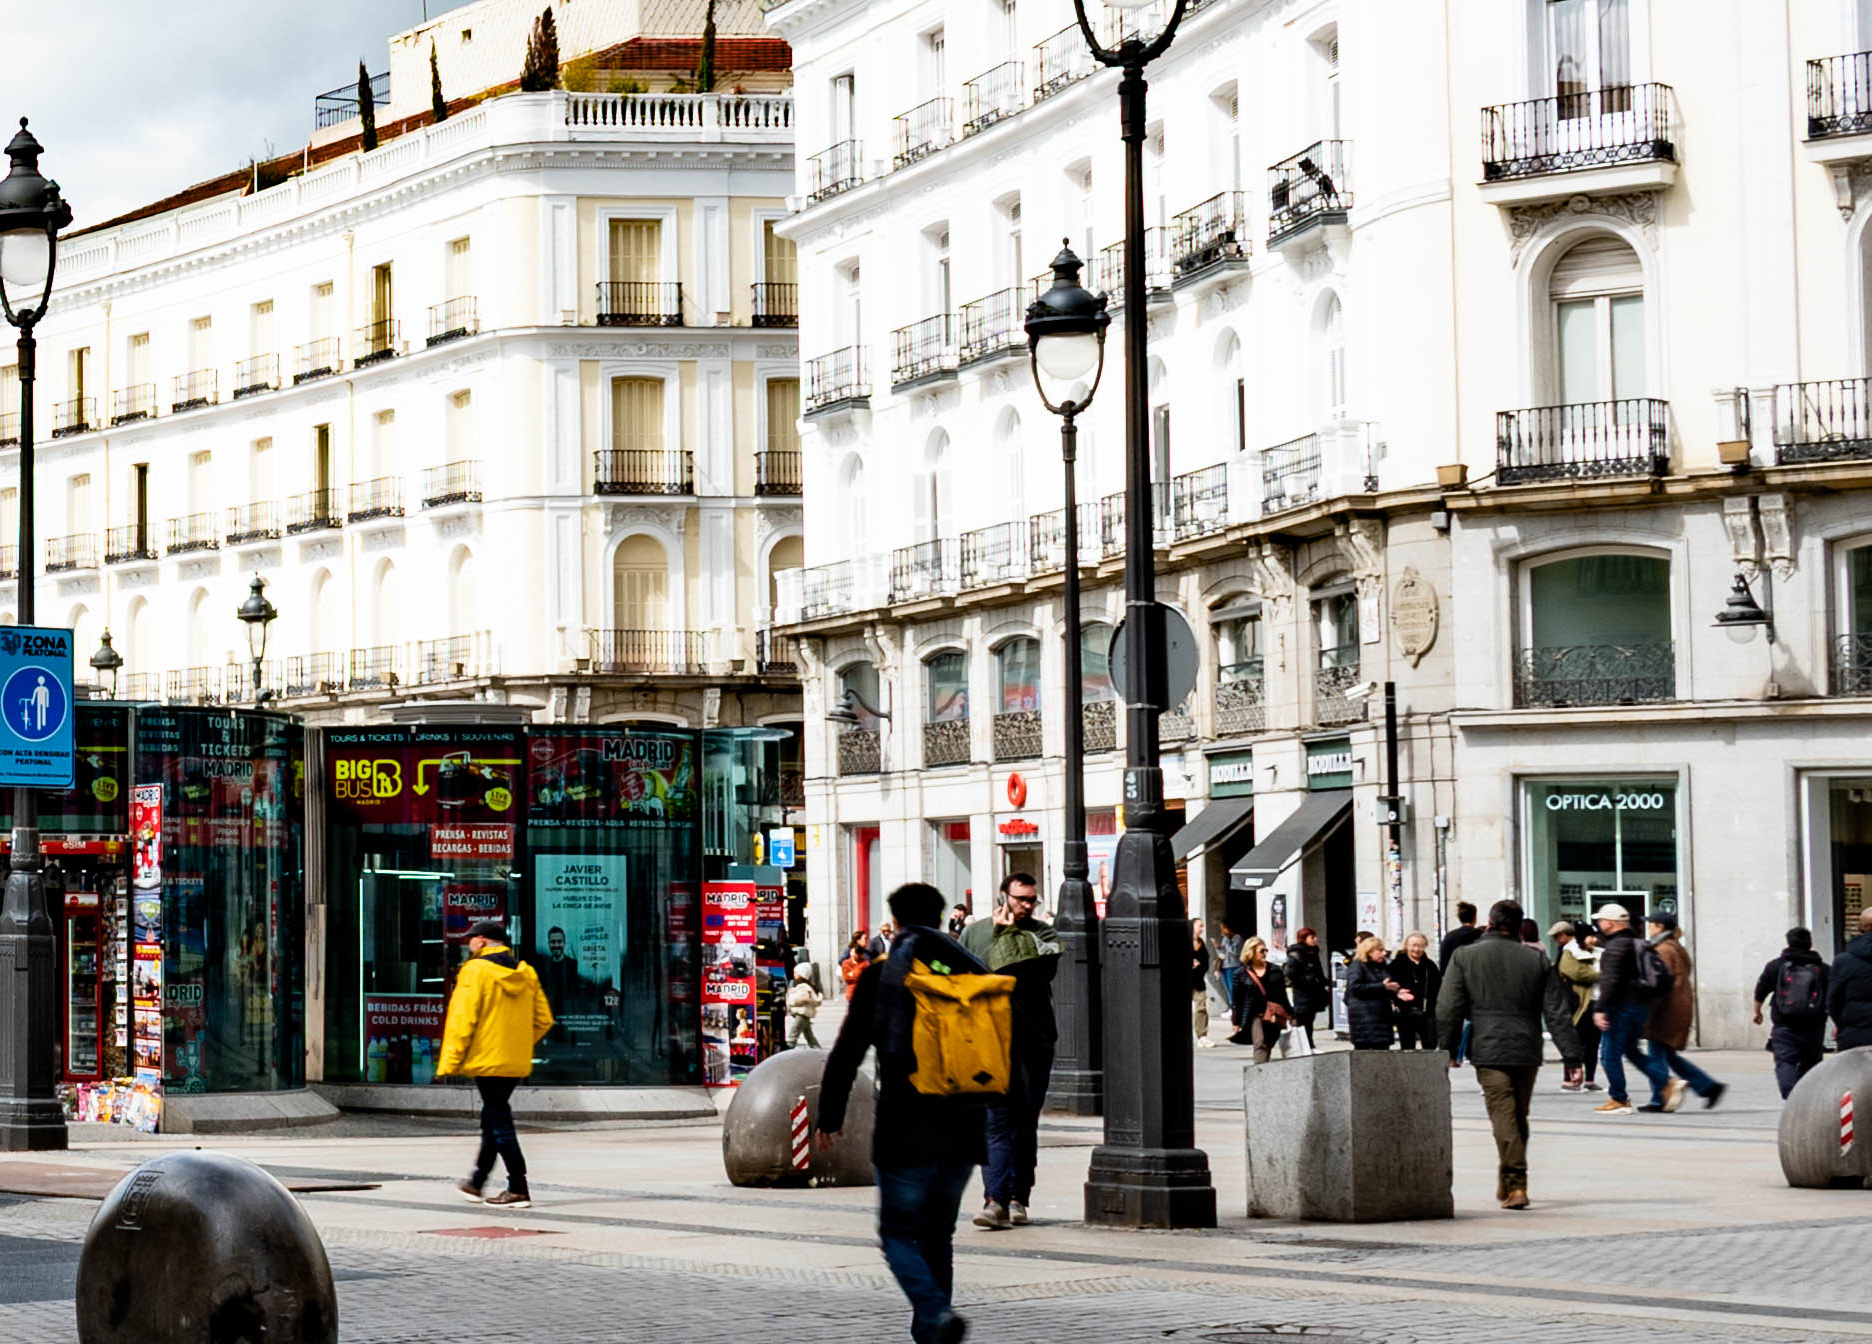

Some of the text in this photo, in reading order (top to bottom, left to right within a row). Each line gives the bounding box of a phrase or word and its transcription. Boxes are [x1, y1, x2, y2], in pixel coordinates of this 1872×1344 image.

[23, 635, 67, 649] ZONA
[23, 648, 68, 658] PEATONAL
[207, 717, 245, 729] TOURS
[416, 733, 449, 741] DRINKS
[462, 733, 515, 741] SOUVENIRS
[200, 744, 251, 756] TICKETS
[603, 739, 674, 761] MADRID
[15, 758, 52, 766] PEATONAL
[204, 761, 254, 777] MADRID
[336, 760, 372, 779] BIG
[336, 781, 372, 798] BUS
[1546, 793, 1664, 810] OPTICA 2000
[435, 830, 508, 840] PRENSA REVISTAS
[432, 844, 511, 853] RECARGAS BEBIDAS
[563, 865, 602, 874] JAVIER
[555, 876, 609, 885] CASTILLO
[448, 894, 498, 906] MADRID
[706, 893, 749, 904] MADRID
[706, 984, 749, 994] MADRID
[367, 1002, 443, 1013] BEBIDAS FRÍAS
[372, 1015, 439, 1025] COLD DRINKS
